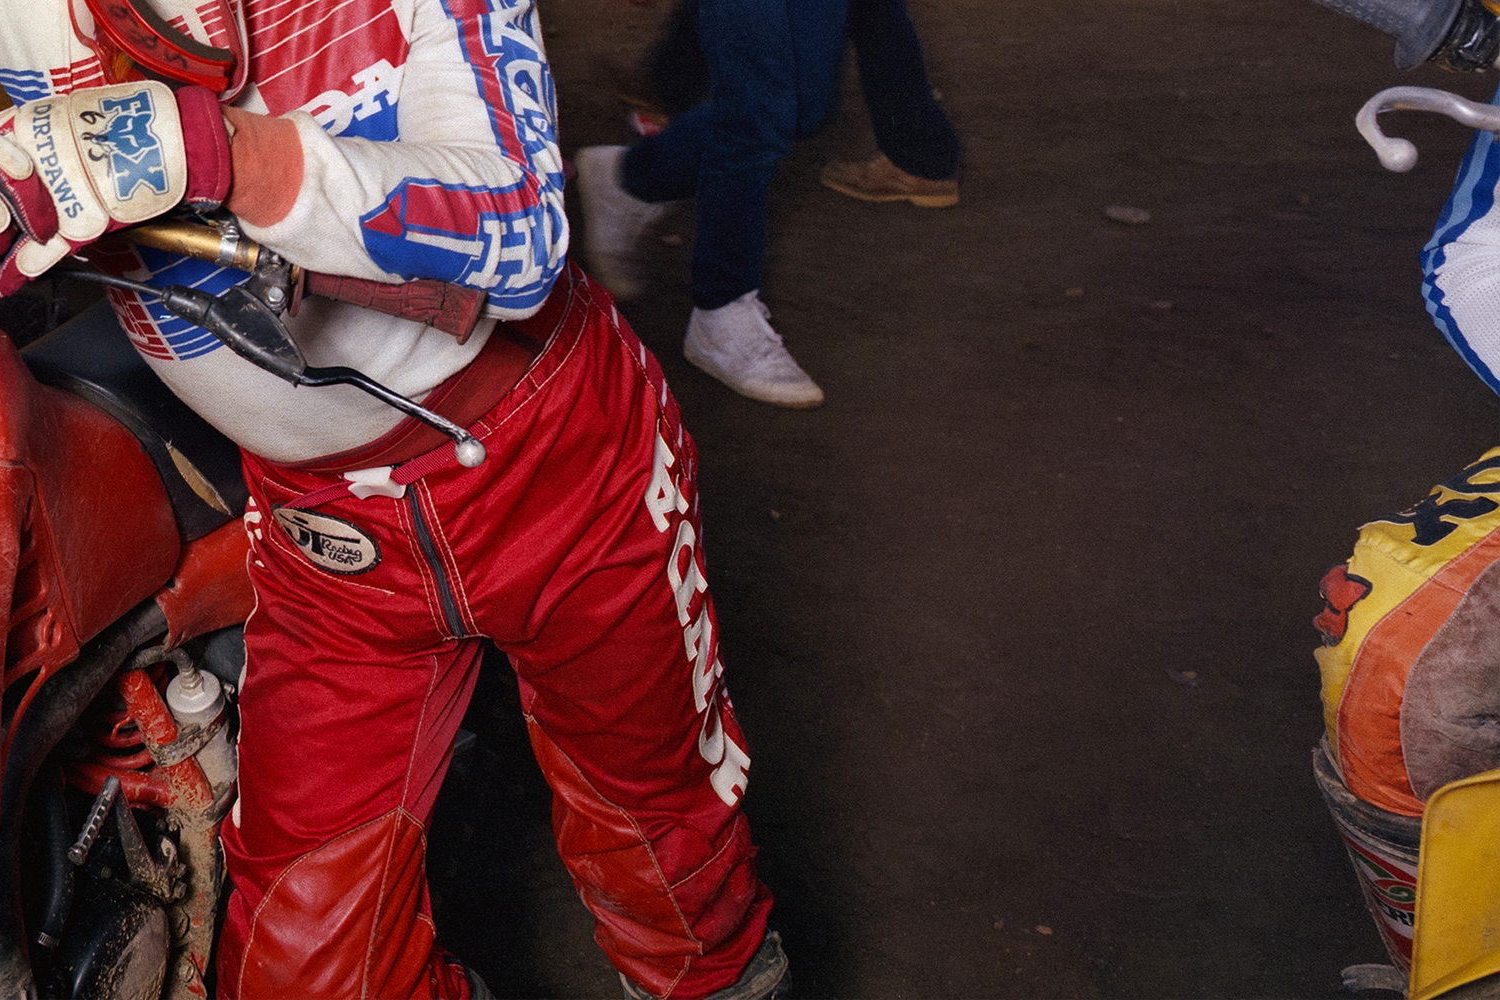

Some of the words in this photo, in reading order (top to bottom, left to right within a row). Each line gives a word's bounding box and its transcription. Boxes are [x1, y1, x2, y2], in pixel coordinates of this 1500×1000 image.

[32, 103, 85, 219] DIRTPAWS
[101, 90, 168, 199] FOX
[321, 537, 363, 563] Racing
[328, 551, 355, 566] USA
